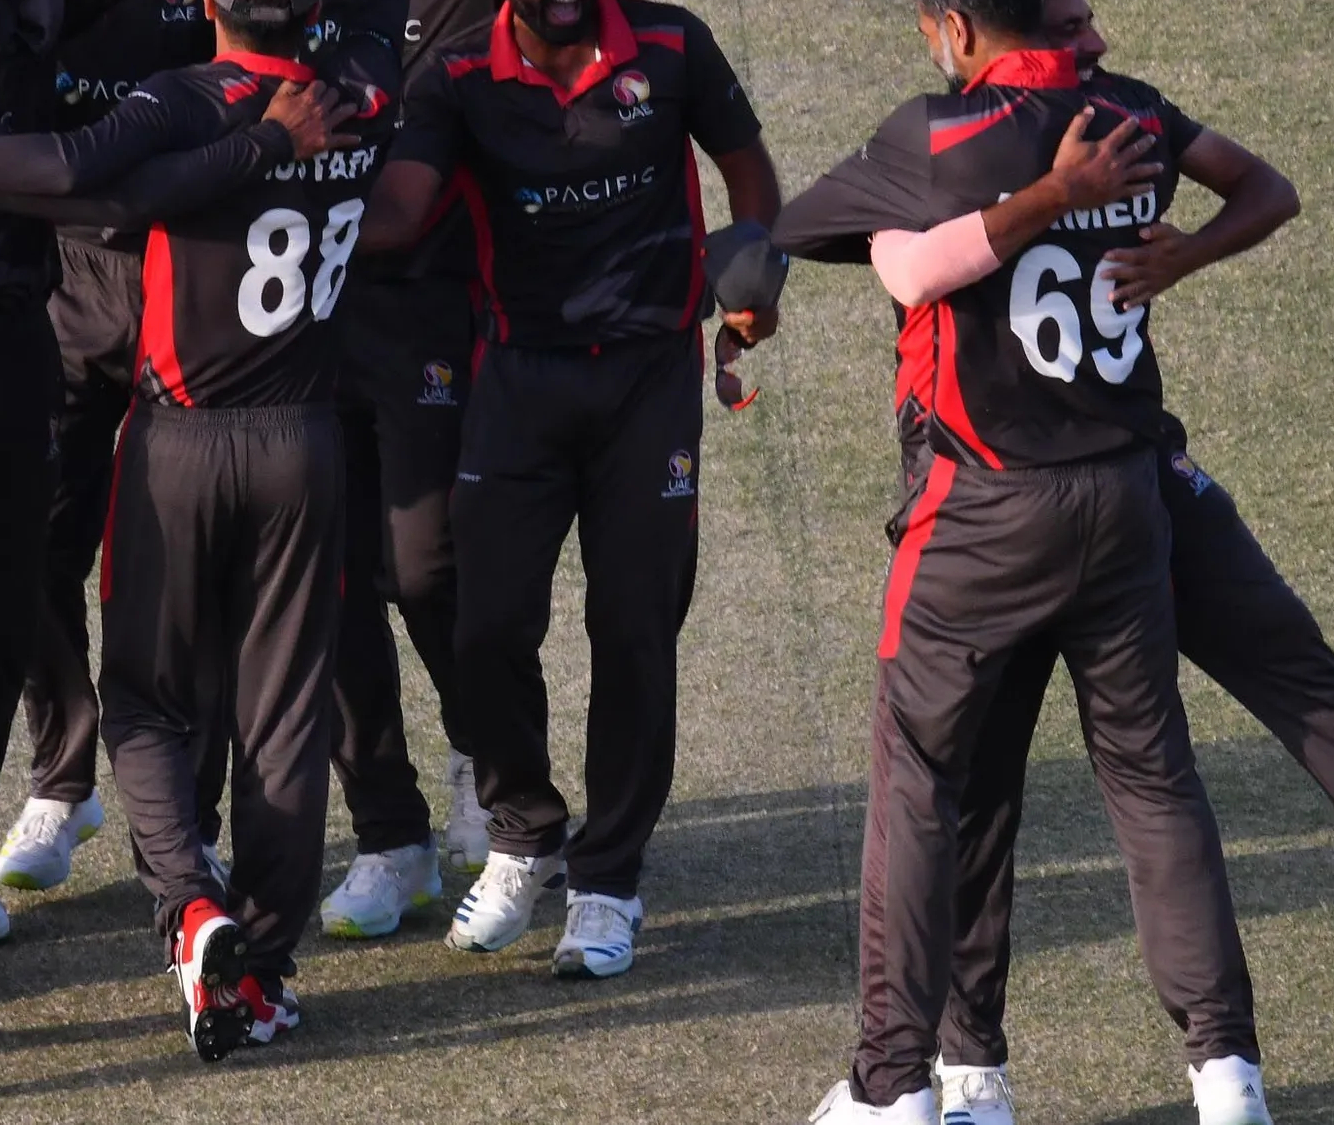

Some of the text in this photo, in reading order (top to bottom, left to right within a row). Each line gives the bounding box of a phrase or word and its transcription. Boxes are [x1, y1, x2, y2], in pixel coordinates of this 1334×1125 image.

[161, 6, 197, 22] UAE
[618, 102, 654, 122] UAE
[545, 166, 655, 203] PACIFIC
[238, 197, 365, 337] 88
[1010, 244, 1145, 385] 69
